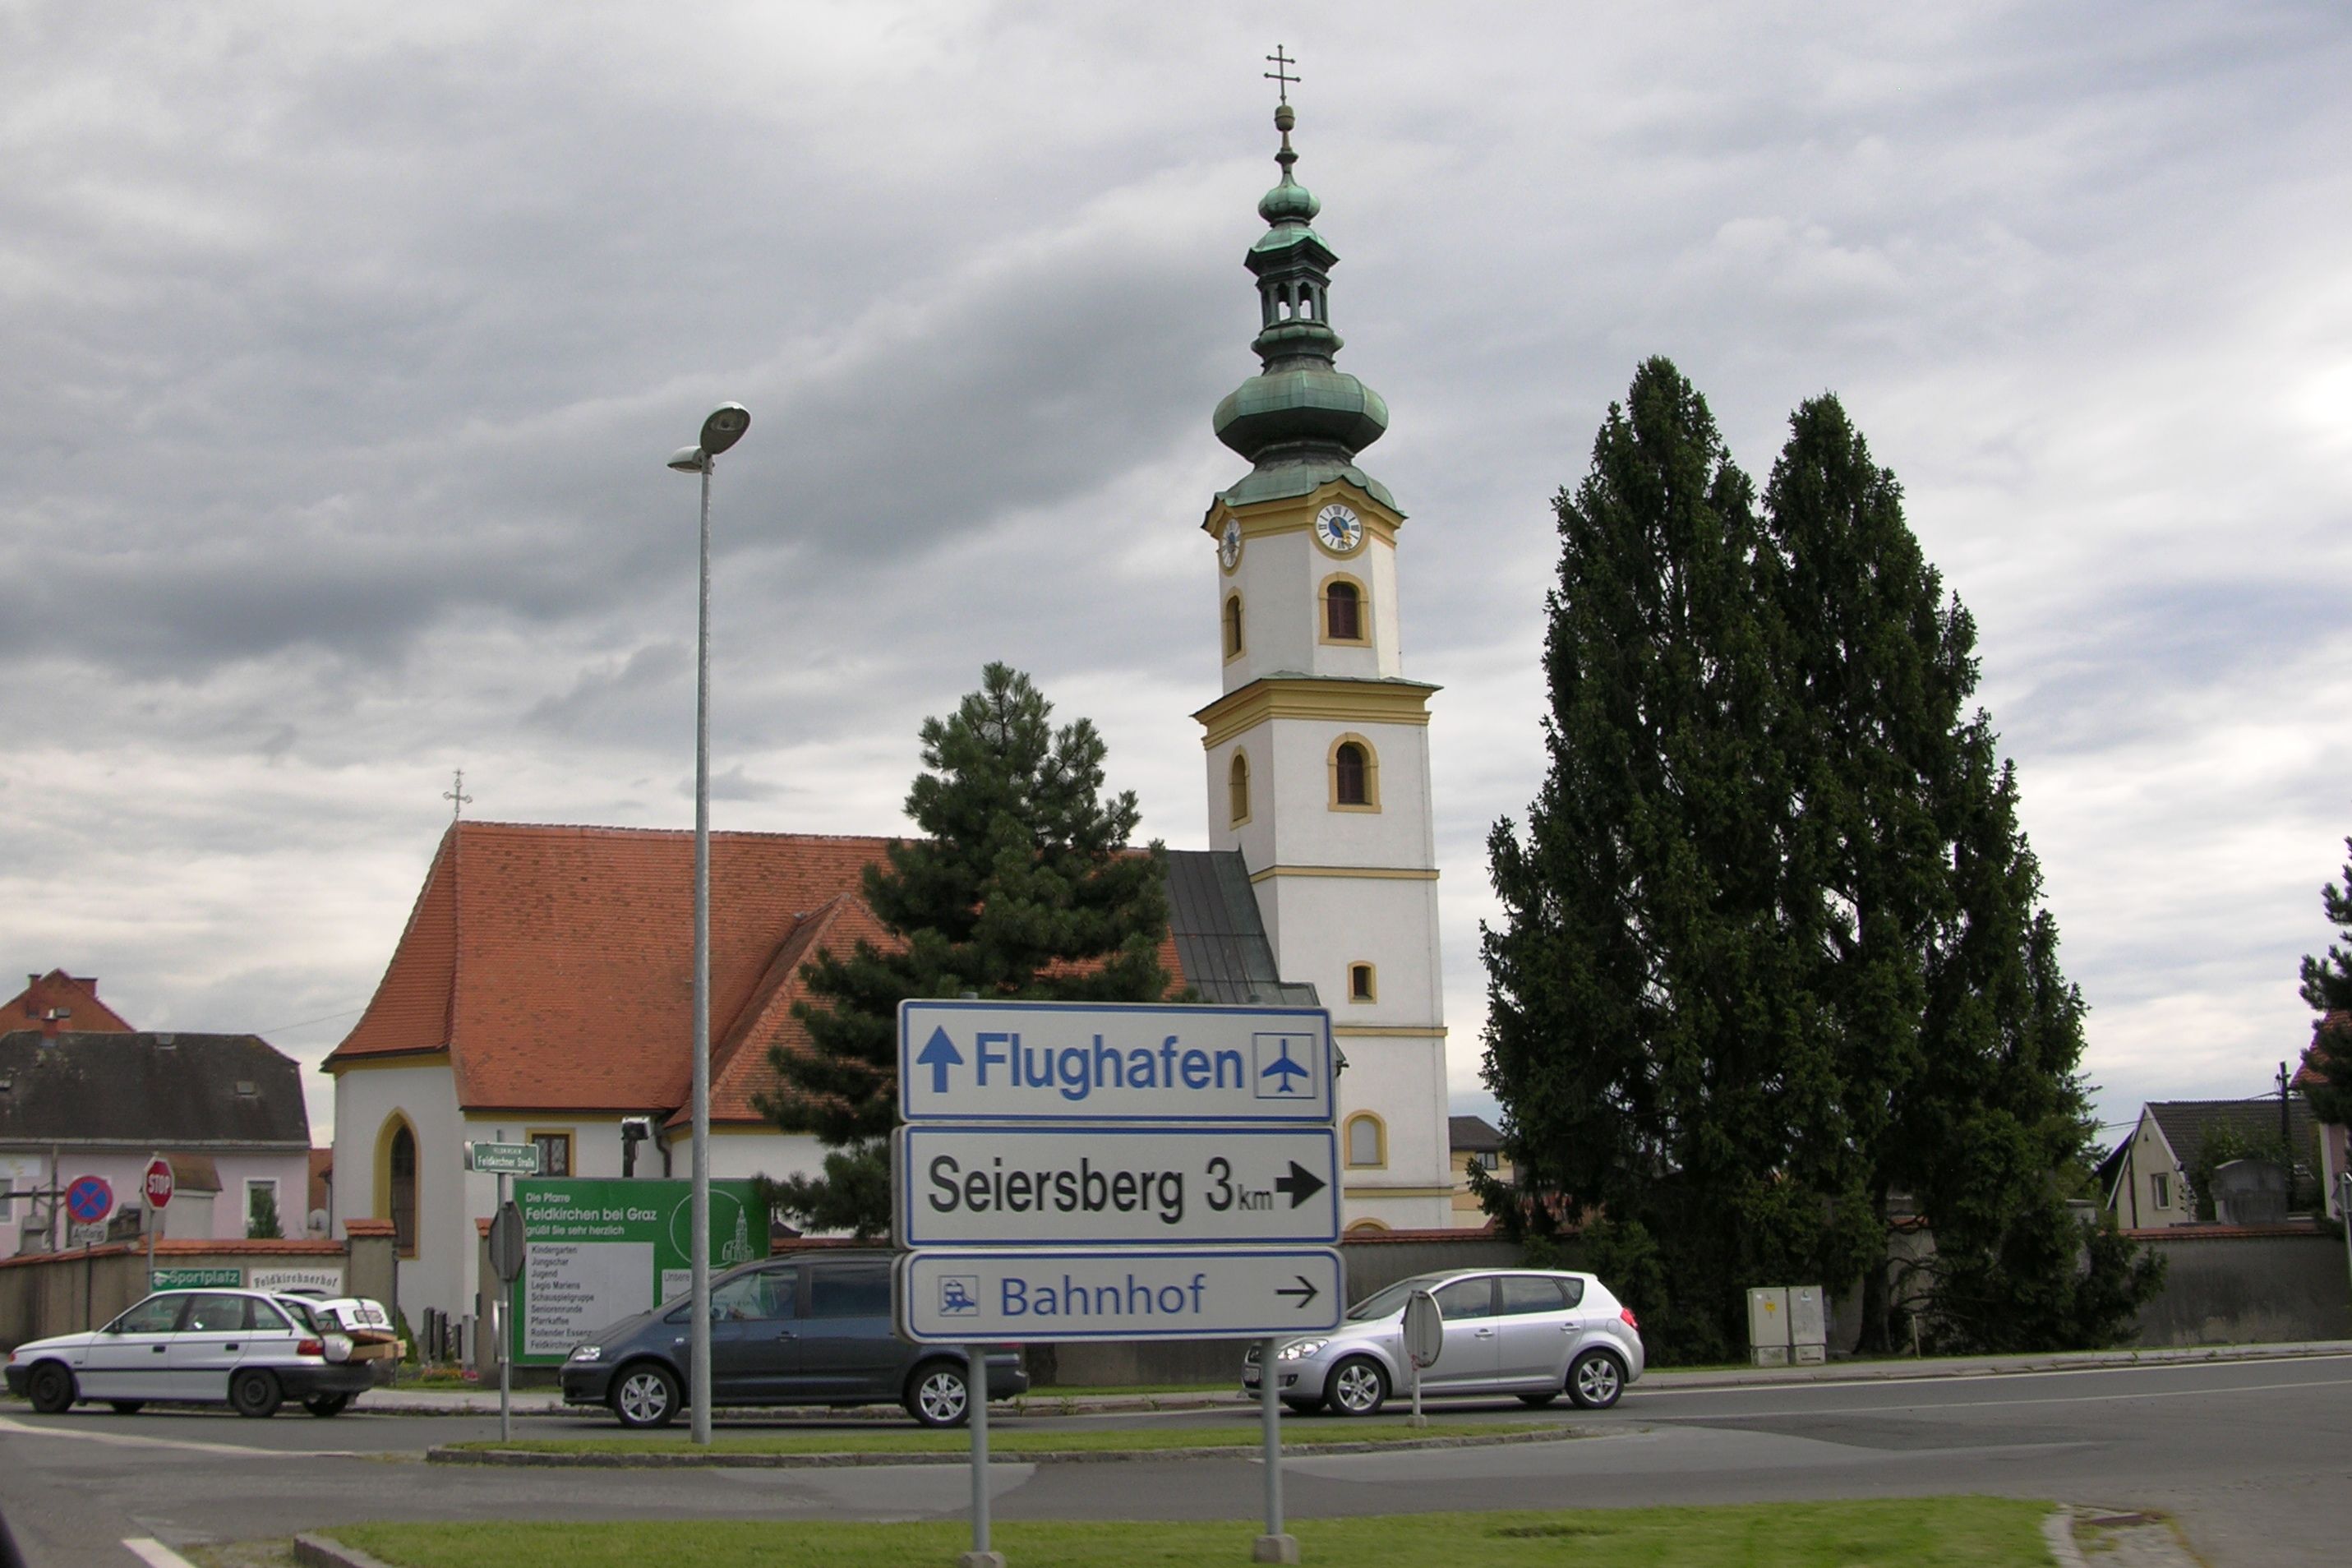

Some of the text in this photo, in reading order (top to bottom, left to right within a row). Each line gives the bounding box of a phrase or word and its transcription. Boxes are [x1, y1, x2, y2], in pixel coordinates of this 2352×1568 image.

[975, 1032, 1244, 1101] Flughafen
[148, 1174, 171, 1195] STOP
[929, 1155, 1274, 1224] Seiersberg 3 km
[526, 1192, 570, 1203] Die Pfarre
[526, 1207, 657, 1221] Feldkirchen bei Graz
[551, 1225, 565, 1235] Sie
[568, 1225, 587, 1235] sehr
[588, 1225, 625, 1236] herzlich
[532, 1245, 578, 1257] Kindergarten
[532, 1258, 570, 1268] Jungschar
[168, 1272, 239, 1284] Sportplatz
[531, 1269, 558, 1280] Jugend
[664, 1274, 691, 1282] Unsere
[254, 1274, 339, 1289] Feldkirchnerhof
[531, 1293, 595, 1303] Schauspielgruppe
[1001, 1274, 1206, 1317] Bahnhof
[531, 1304, 583, 1313] Seniorenrunde
[531, 1328, 565, 1336] Rollender
